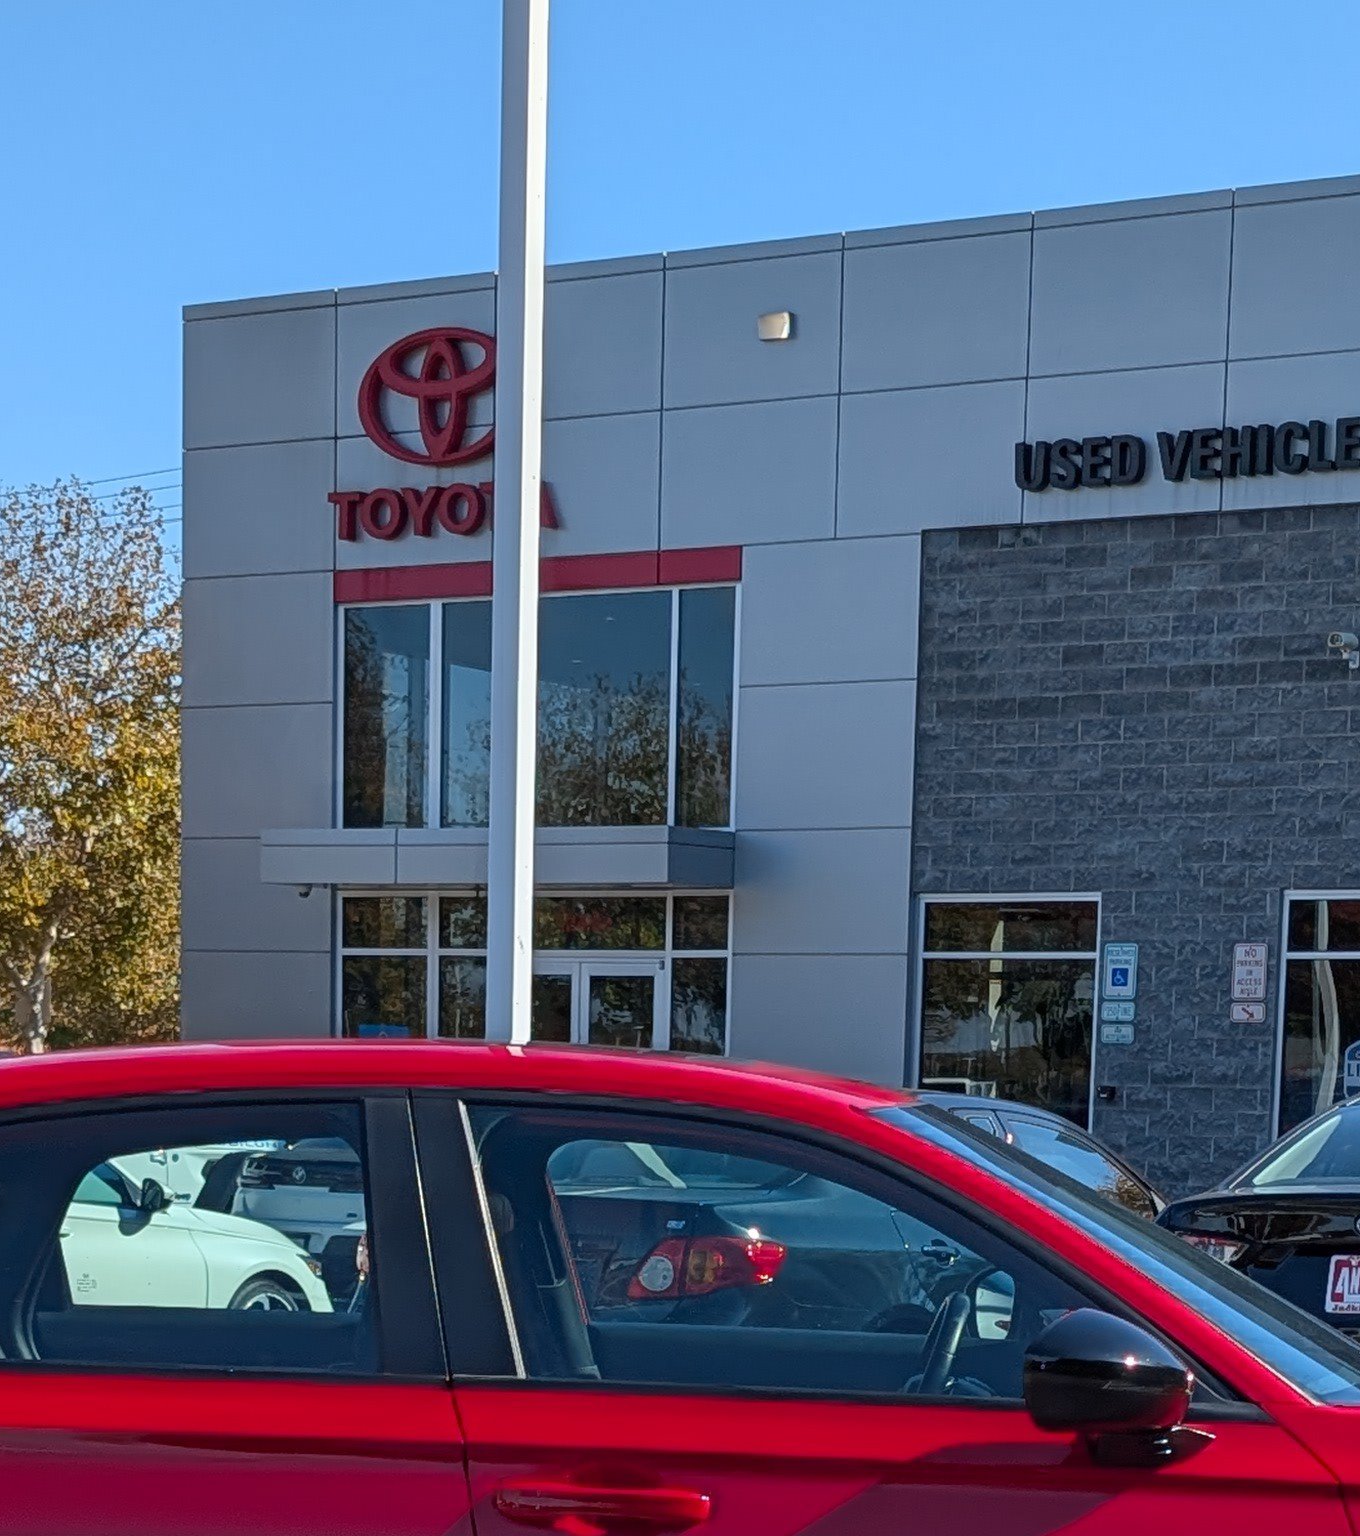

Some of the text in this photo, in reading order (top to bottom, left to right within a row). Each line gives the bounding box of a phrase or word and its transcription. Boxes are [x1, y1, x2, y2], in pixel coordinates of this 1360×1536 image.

[1014, 434, 1146, 493] USED
[327, 481, 559, 542] TOYO
[1244, 949, 1257, 958] NO
